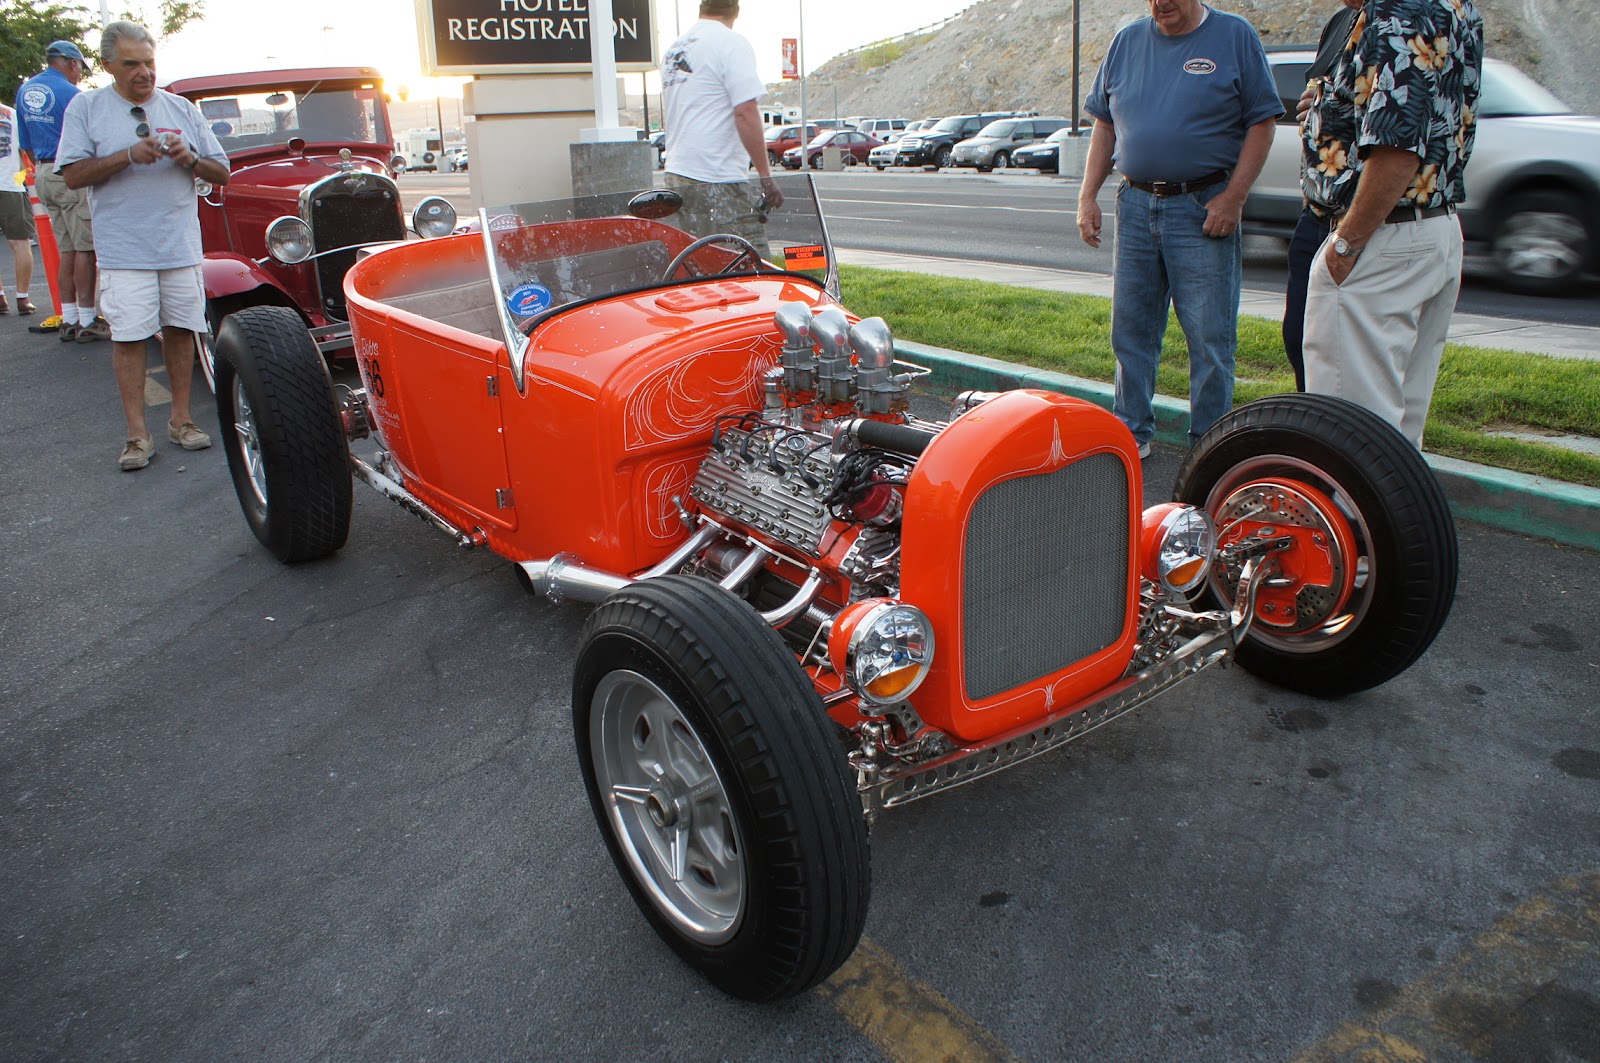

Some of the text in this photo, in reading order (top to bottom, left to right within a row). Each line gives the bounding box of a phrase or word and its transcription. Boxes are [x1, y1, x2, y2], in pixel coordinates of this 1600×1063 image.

[448, 18, 638, 41] REGISTRATN
[25, 92, 44, 104] Ford
[785, 246, 822, 254] PARTICIPANT
[534, 305, 544, 314] WEEK
